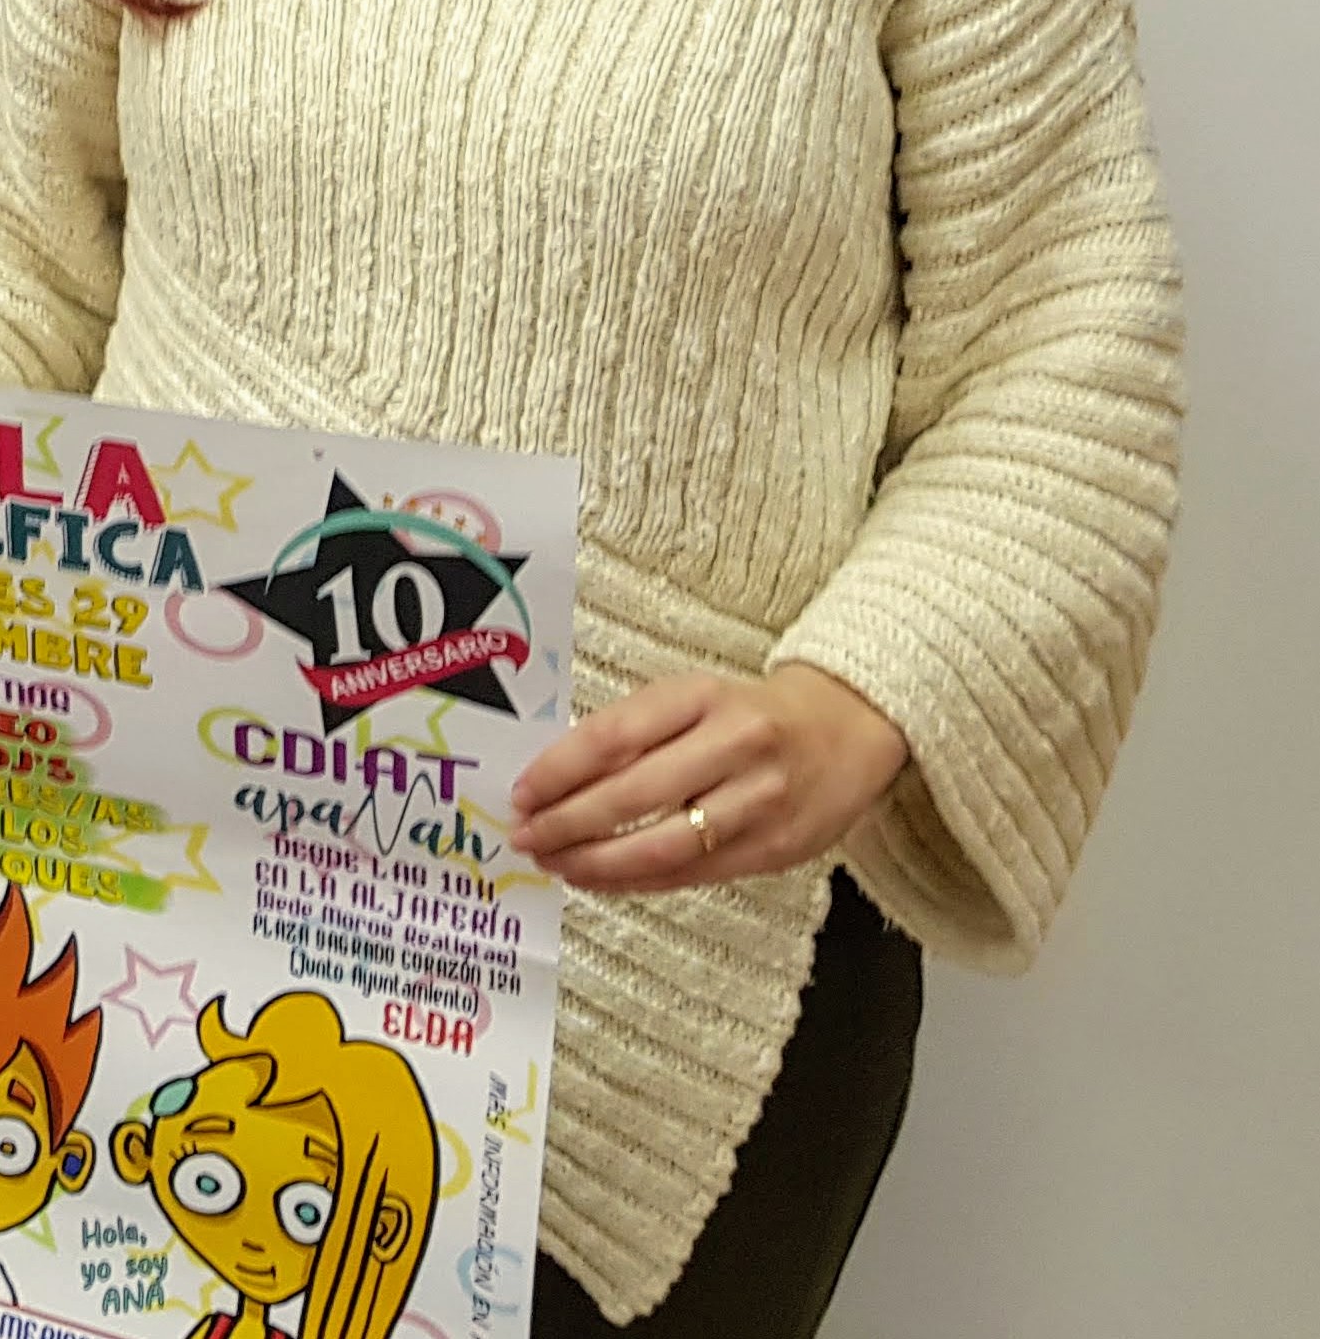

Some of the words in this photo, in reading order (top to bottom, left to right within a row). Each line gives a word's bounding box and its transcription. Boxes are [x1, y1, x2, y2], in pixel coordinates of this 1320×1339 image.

[72, 584, 150, 636] 29
[317, 561, 444, 665] 10
[331, 631, 508, 701] ANIVERSARIO
[233, 723, 479, 803] CDIAT
[1, 809, 88, 857] LOS
[255, 862, 288, 891] EN
[300, 870, 337, 900] LA
[383, 1001, 475, 1057] ELDA
[82, 1217, 147, 1249] Hola,
[81, 1262, 111, 1290] yo
[127, 1253, 167, 1280] soy
[102, 1279, 165, 1315] ANA
